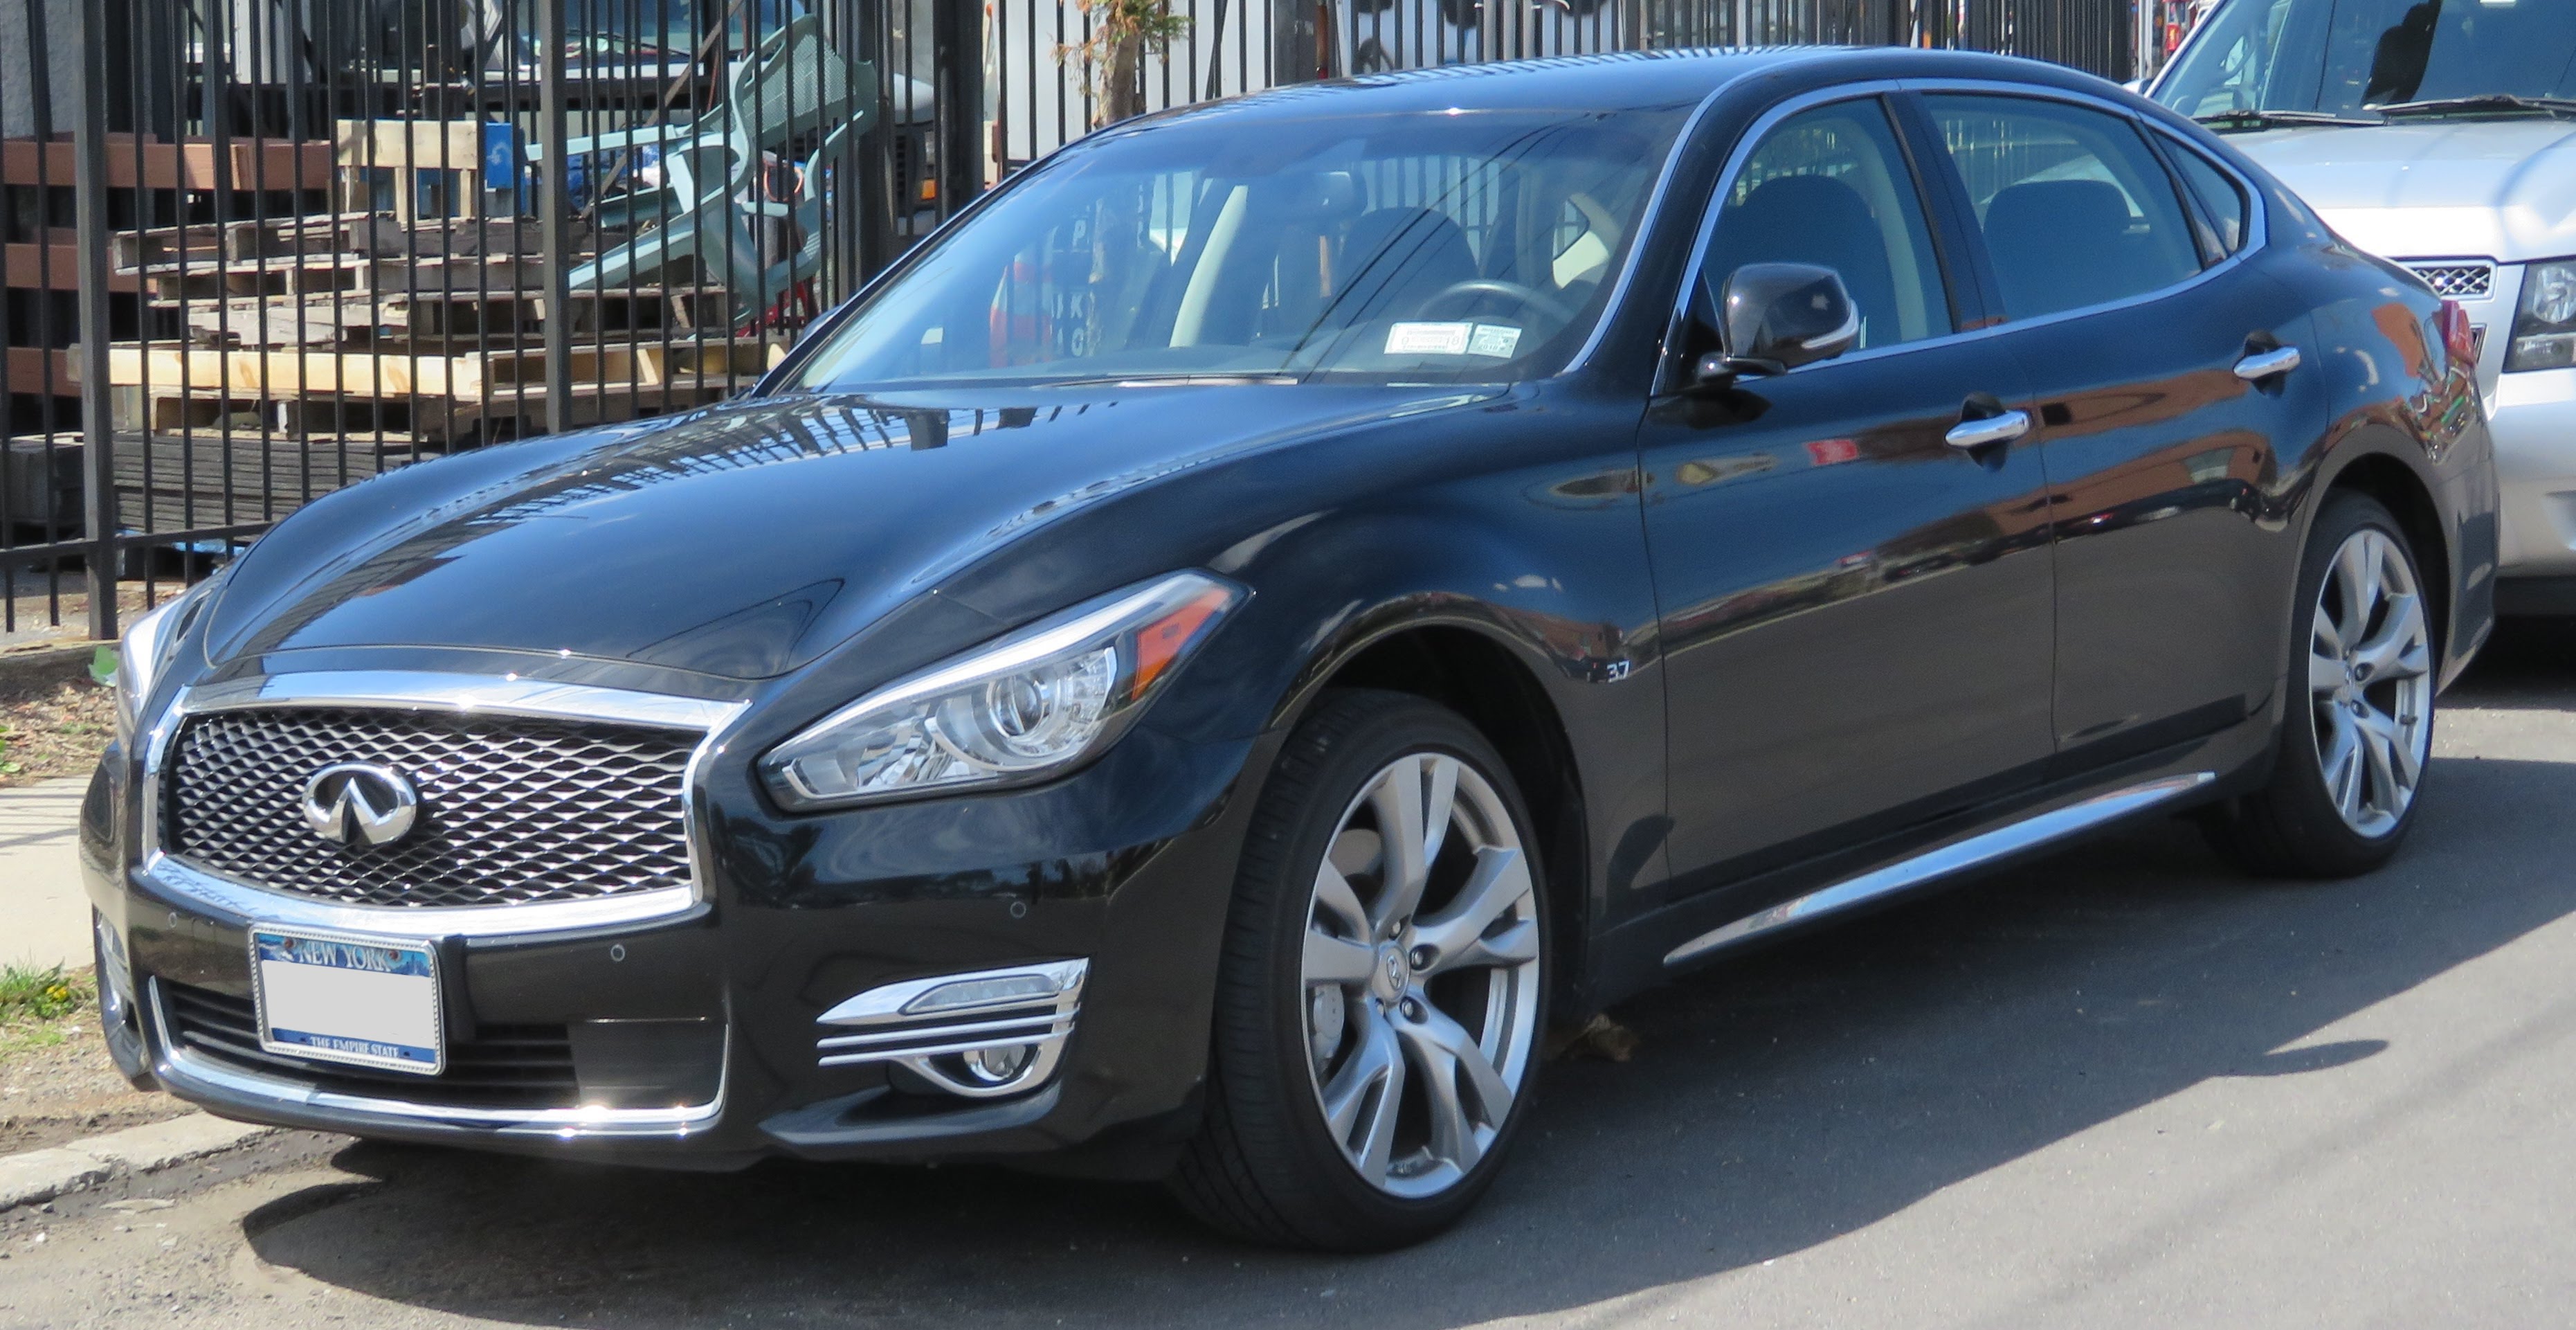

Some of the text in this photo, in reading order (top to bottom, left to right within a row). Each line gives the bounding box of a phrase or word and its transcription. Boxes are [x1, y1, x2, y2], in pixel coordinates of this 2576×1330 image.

[300, 942, 392, 972] NEW YORK
[310, 1036, 399, 1059] THE EMPIRE STATE
